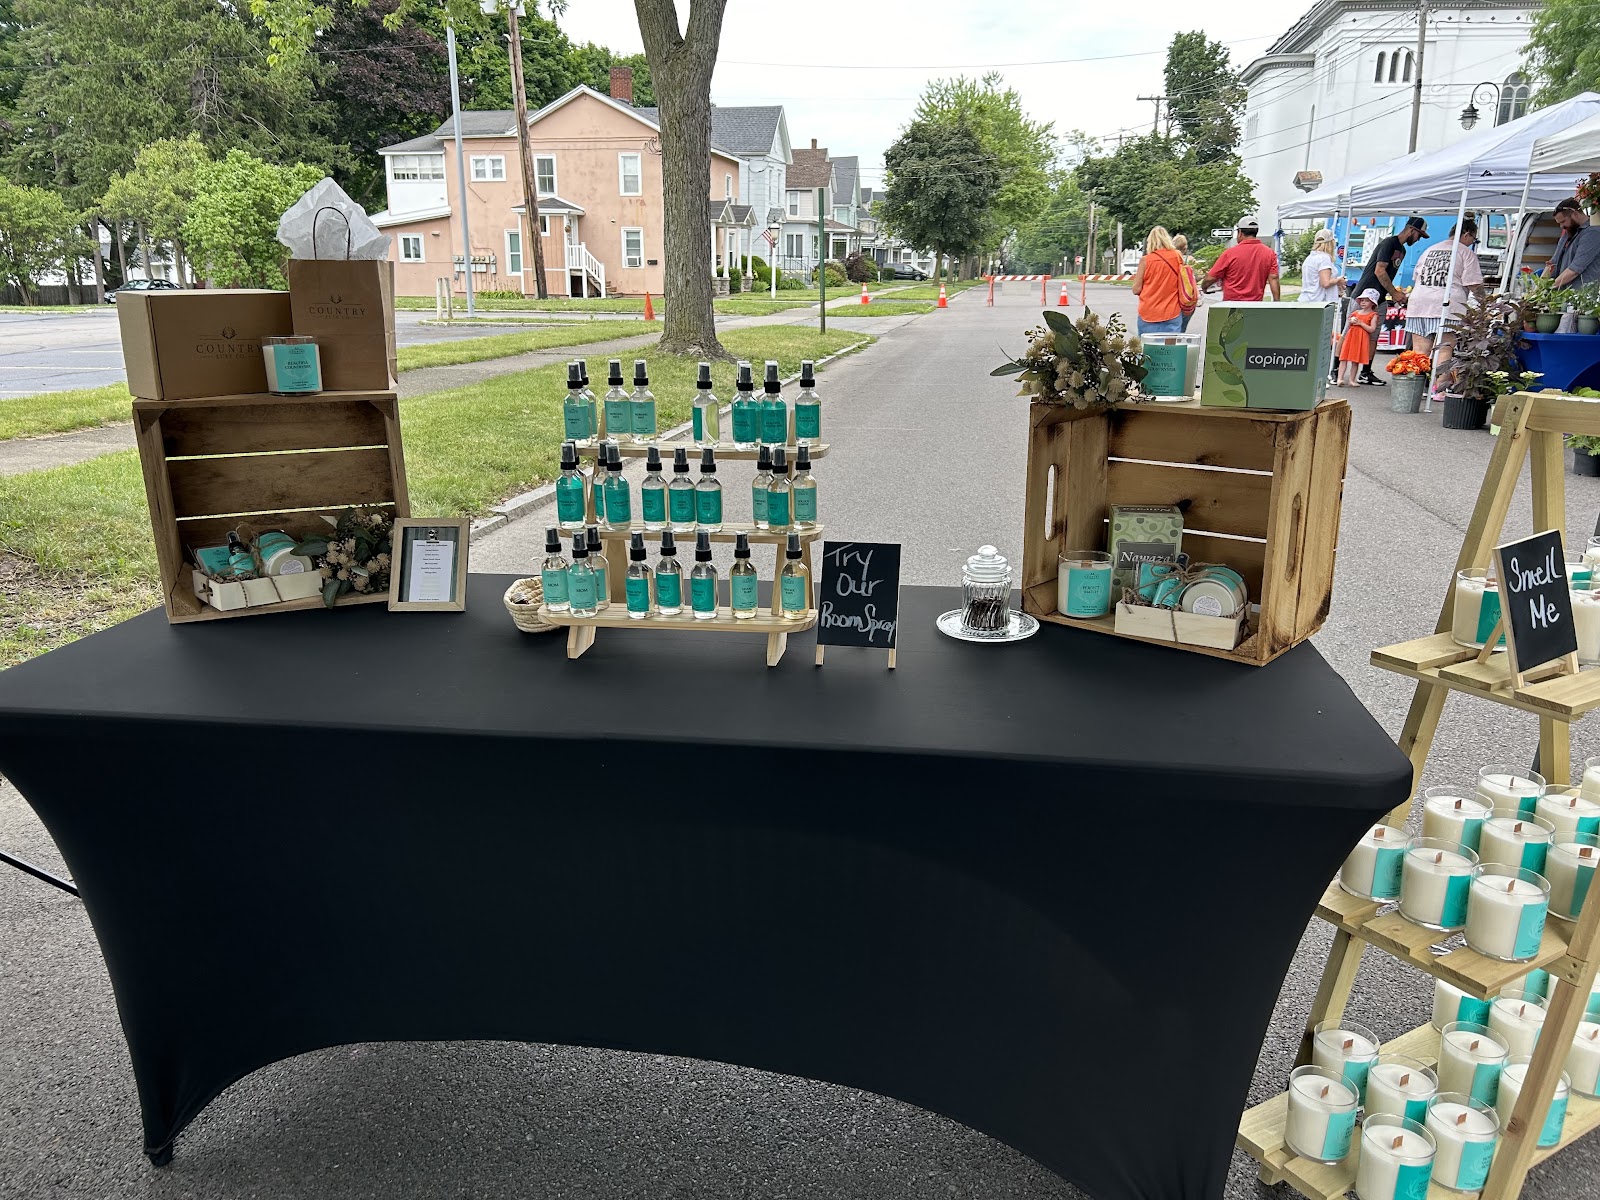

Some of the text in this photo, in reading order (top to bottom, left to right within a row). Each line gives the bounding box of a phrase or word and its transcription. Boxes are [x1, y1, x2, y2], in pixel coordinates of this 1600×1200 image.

[309, 306, 366, 315] COUNTRY
[196, 344, 262, 354] COUNTRY
[1248, 352, 1306, 368] copinpin
[823, 543, 874, 580] Try
[1509, 546, 1562, 593] Smell
[836, 572, 884, 597] Our
[820, 601, 897, 643] Room Spray
[1529, 594, 1560, 630] Me
